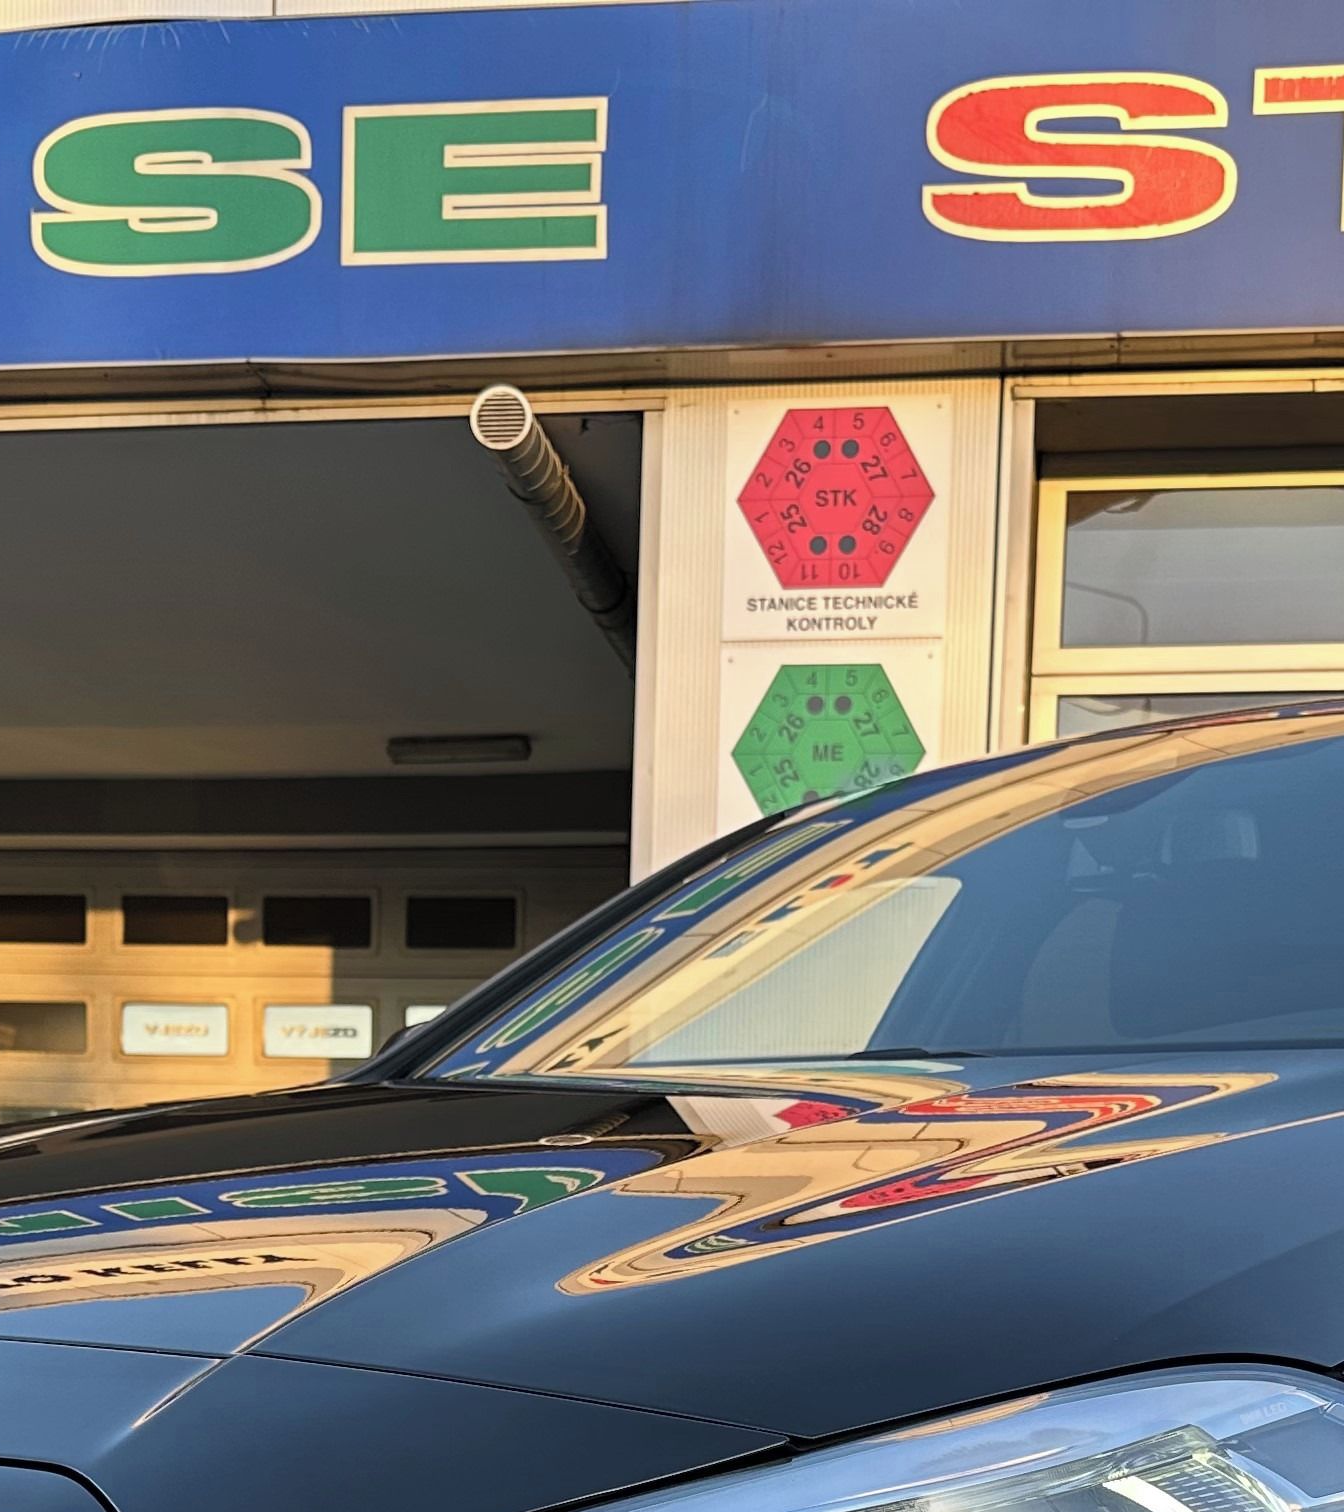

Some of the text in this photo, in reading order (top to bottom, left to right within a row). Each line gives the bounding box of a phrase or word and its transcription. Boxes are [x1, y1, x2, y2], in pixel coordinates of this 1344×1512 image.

[813, 415, 825, 432] 4
[852, 413, 865, 430] 5
[778, 438, 796, 453] 3
[784, 458, 812, 489] 26
[860, 455, 889, 482] 27
[900, 468, 918, 482] 7
[756, 472, 773, 488] 2
[815, 489, 858, 507] STK
[780, 504, 807, 534] 25
[862, 505, 888, 535] 28
[898, 507, 915, 522] 8
[746, 591, 919, 612] STANICE TECHNICKÉ
[786, 616, 878, 632] KONTROLY
[807, 671, 818, 687] 4
[845, 669, 858, 687] 5
[778, 714, 805, 745] 26
[853, 711, 881, 737] 27
[750, 727, 767, 743] 2
[812, 744, 844, 762] ME
[773, 758, 799, 788] 25
